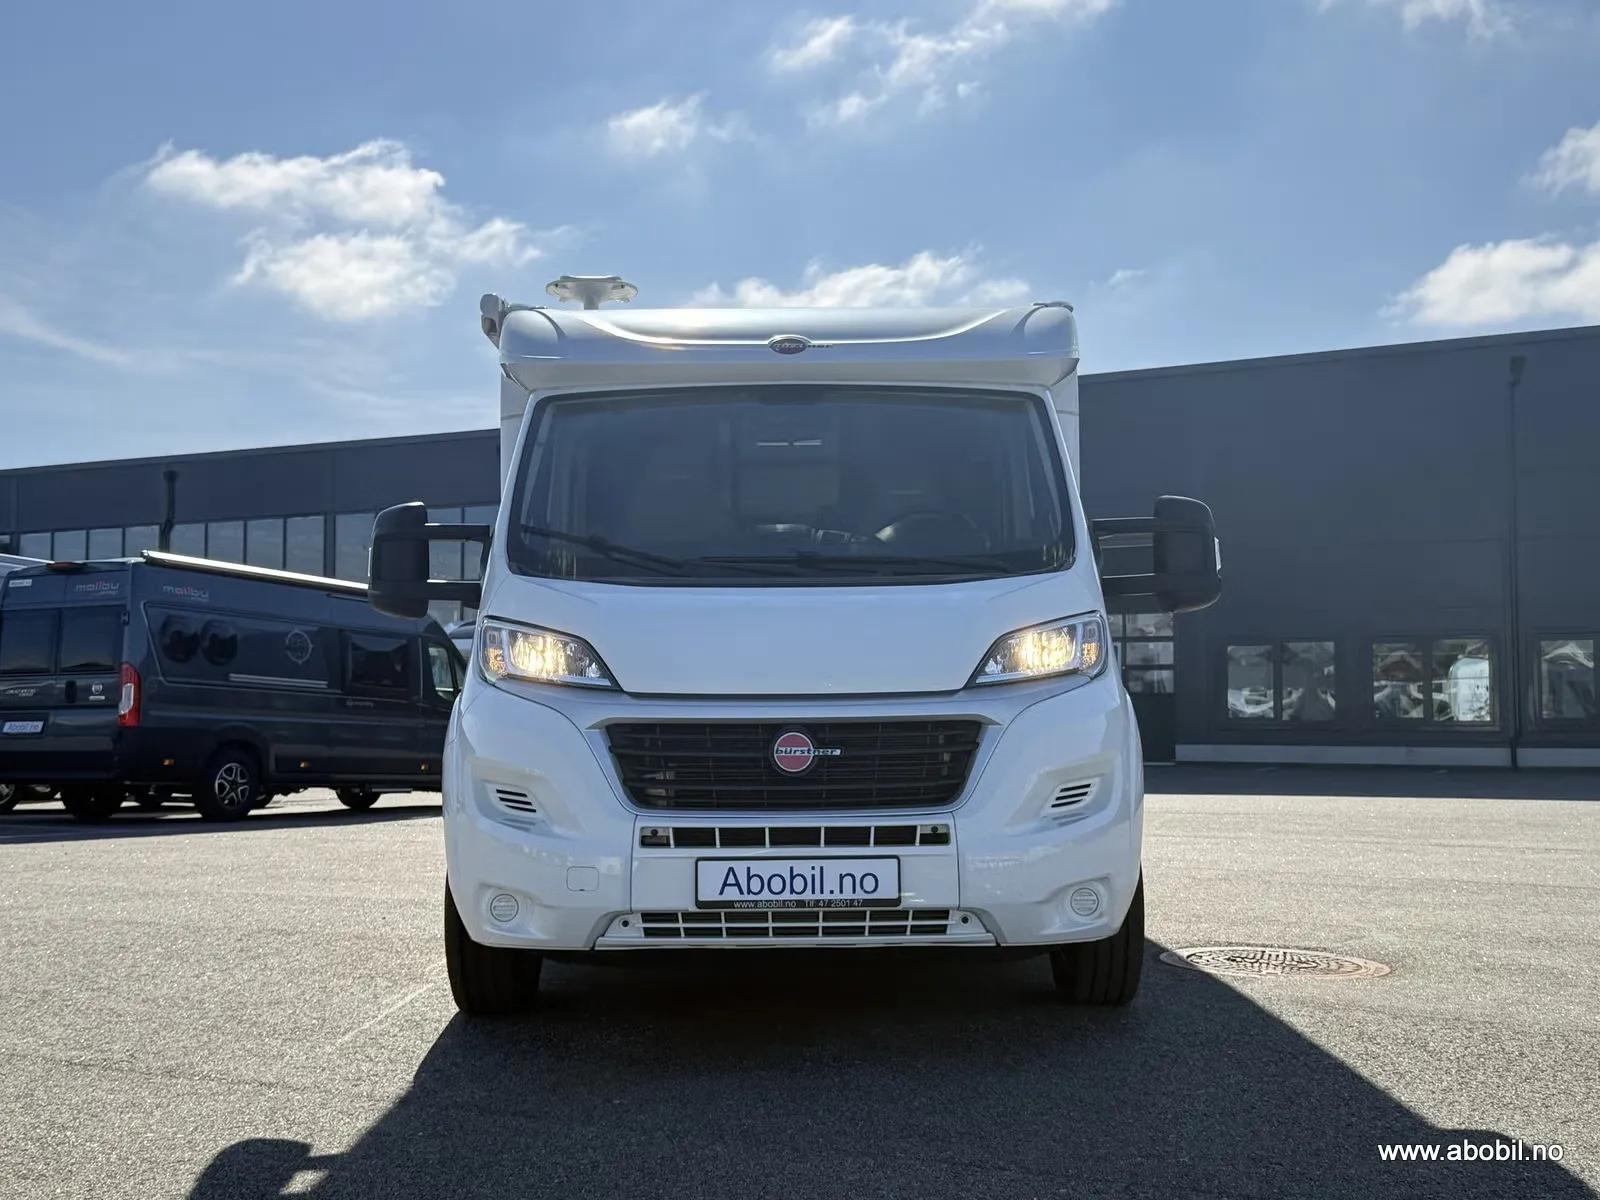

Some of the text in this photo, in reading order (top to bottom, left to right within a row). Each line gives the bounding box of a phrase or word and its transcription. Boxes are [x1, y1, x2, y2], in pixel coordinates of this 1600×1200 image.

[75, 580, 120, 592] malibu
[163, 583, 210, 598] malibu
[775, 747, 838, 755] bürstner
[718, 866, 880, 896] Abobil.no
[733, 900, 797, 909] www.abobil.no
